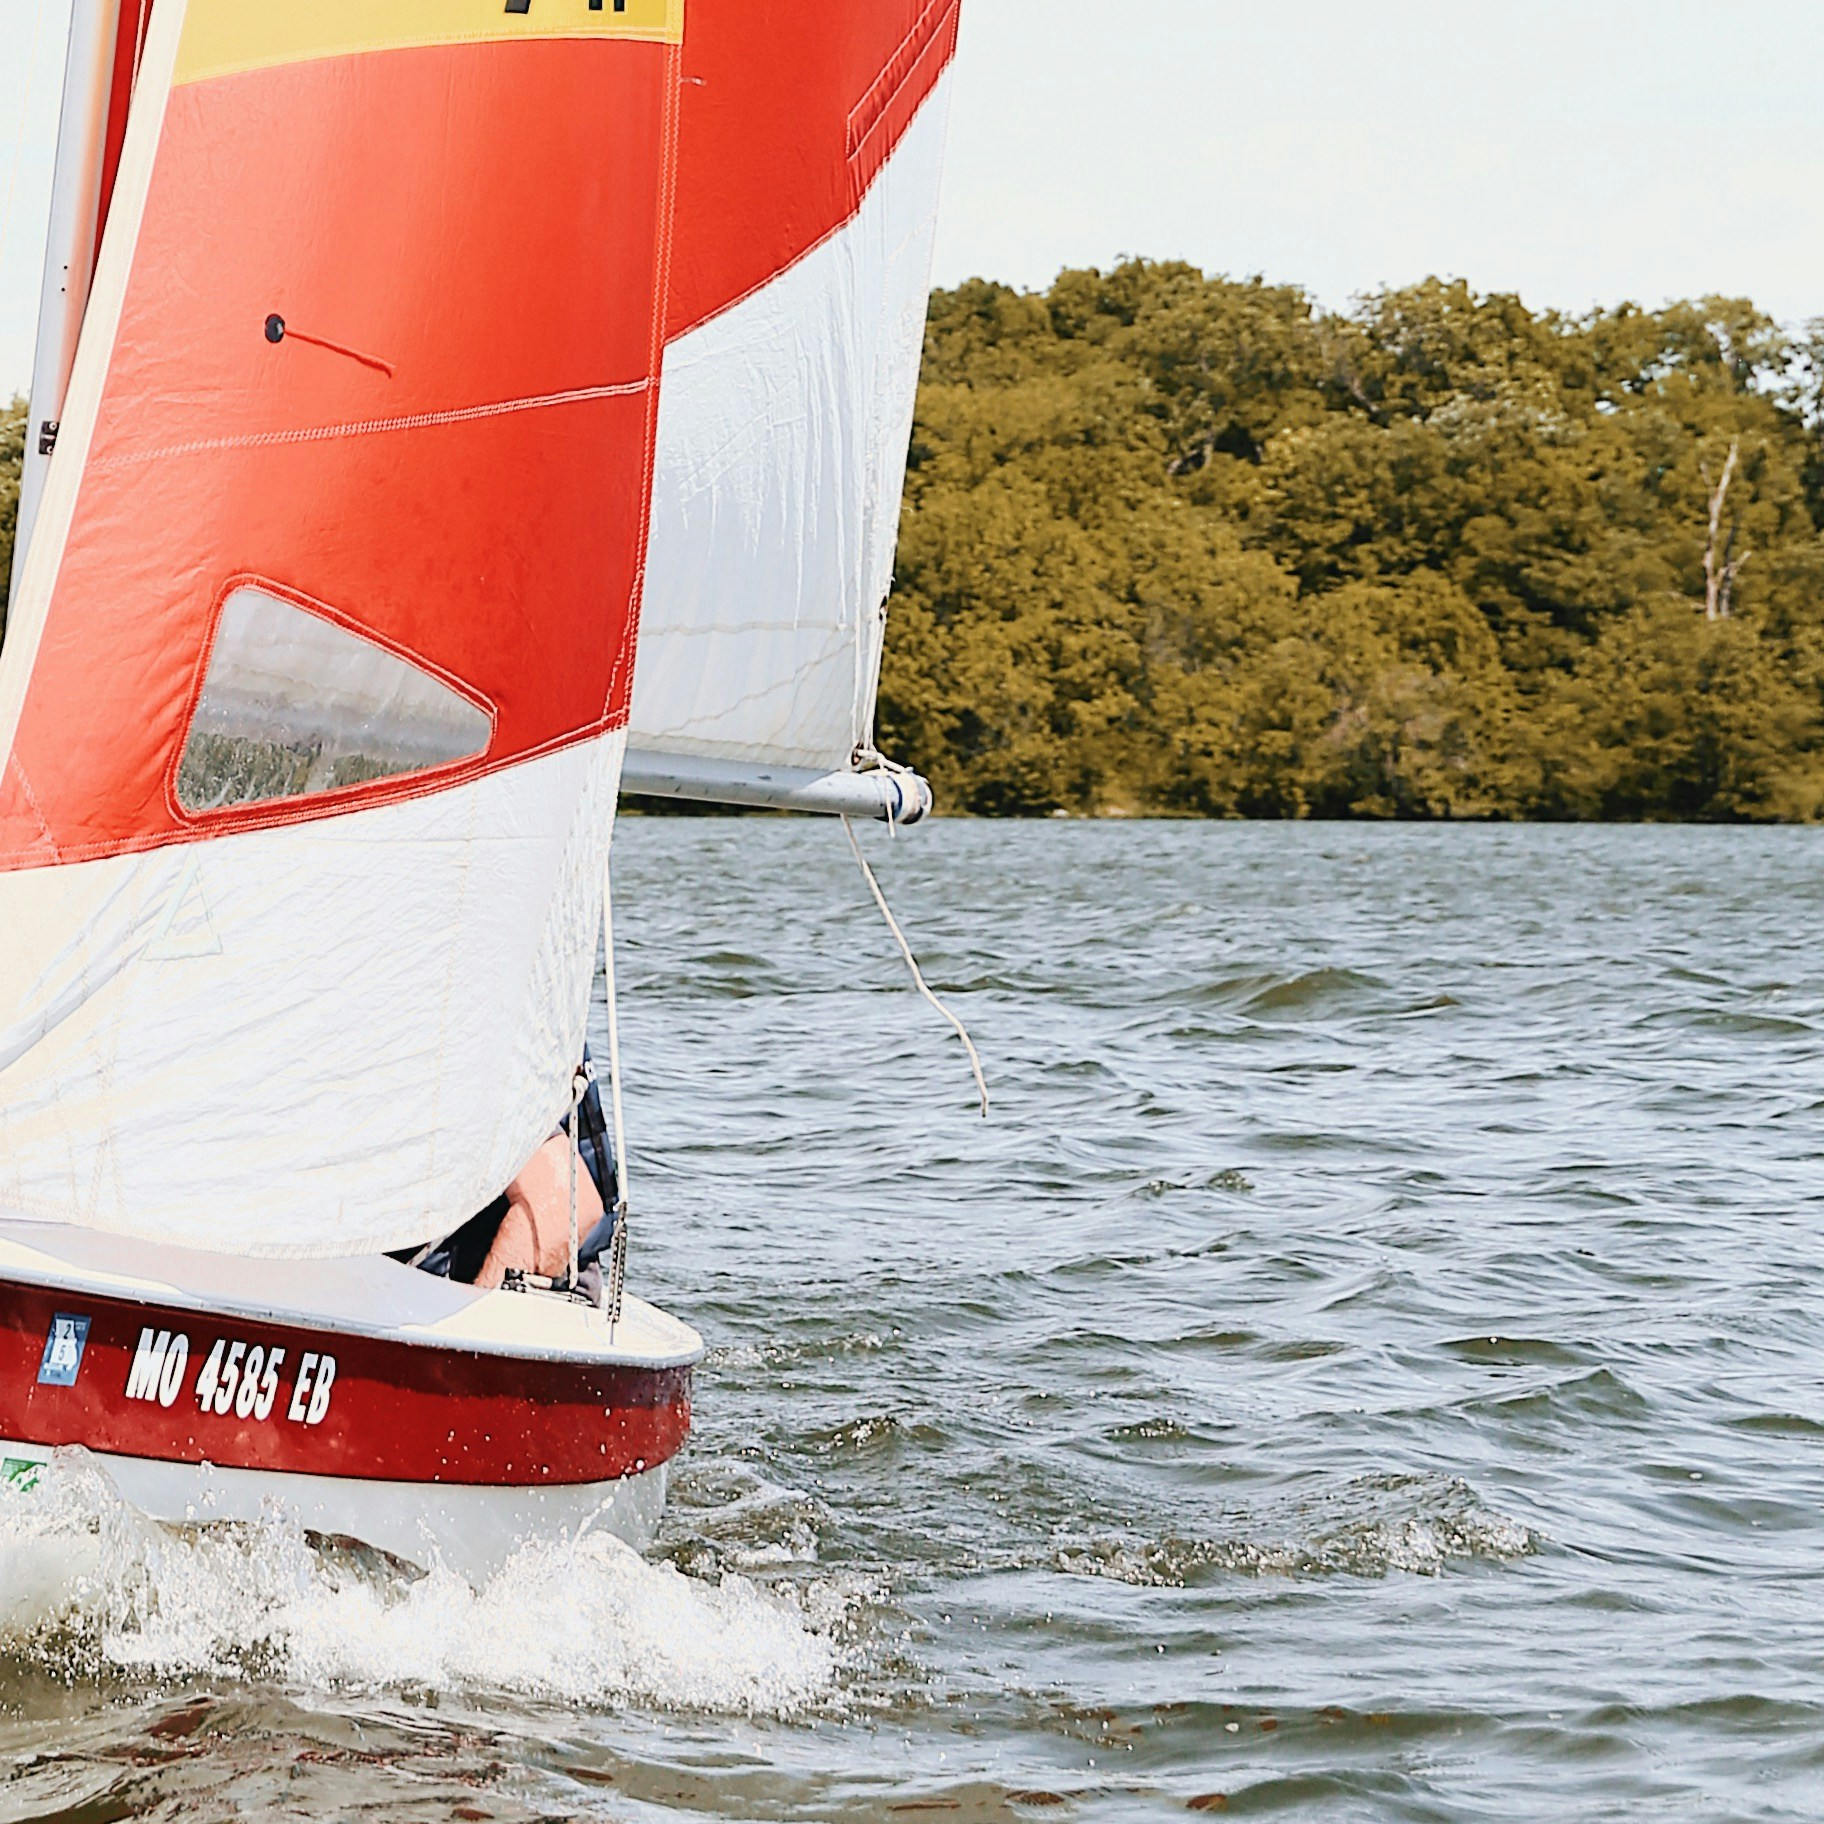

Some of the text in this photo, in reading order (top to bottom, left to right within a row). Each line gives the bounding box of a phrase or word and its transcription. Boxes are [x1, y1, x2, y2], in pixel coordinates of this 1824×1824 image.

[63, 1323, 72, 1340] 2
[125, 1326, 337, 1425] MO 4585 EB
